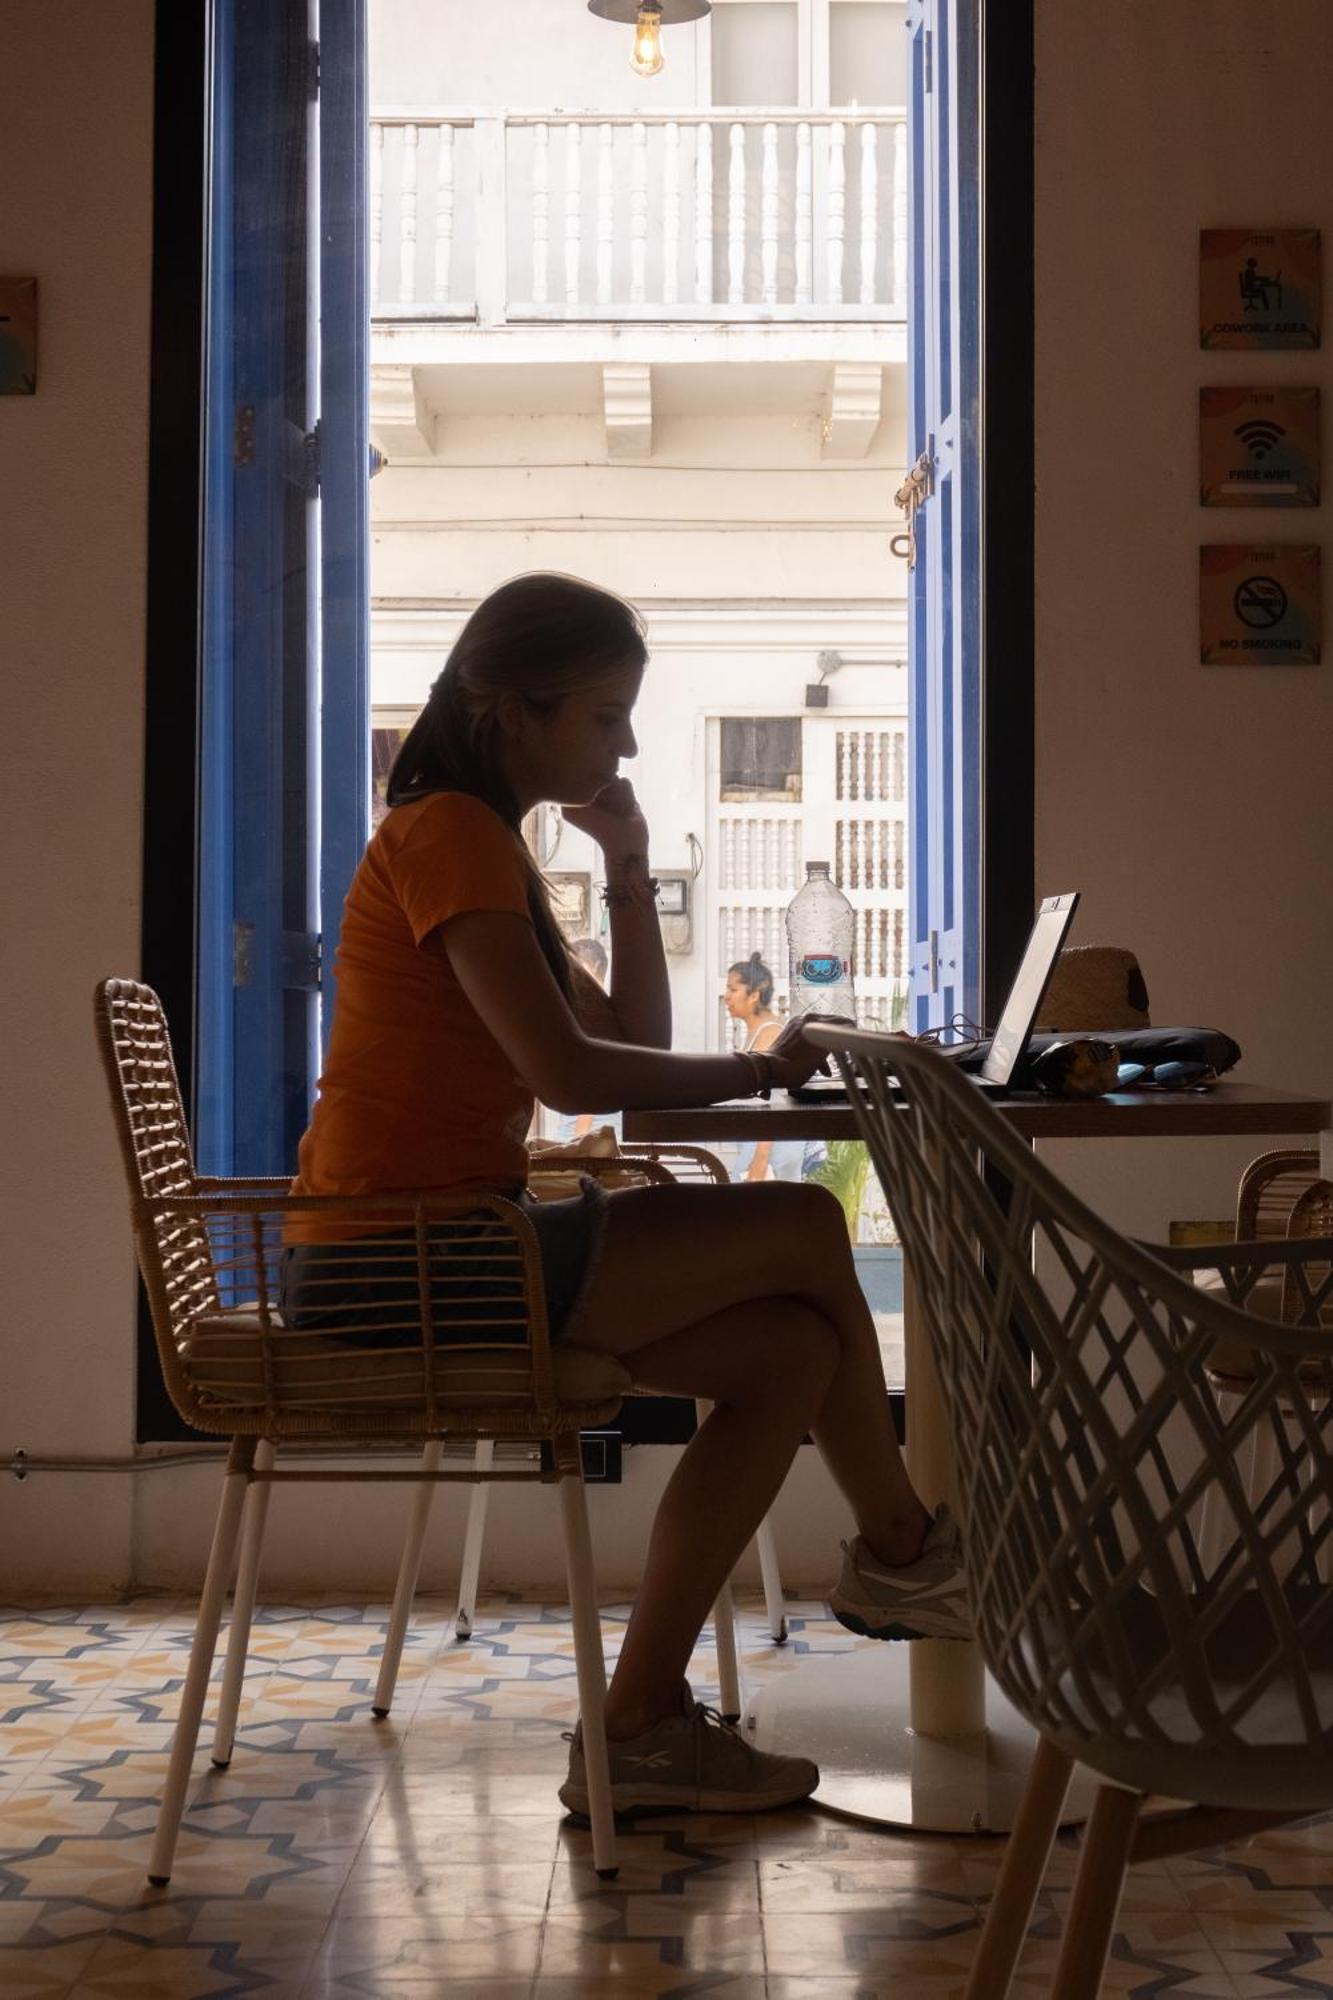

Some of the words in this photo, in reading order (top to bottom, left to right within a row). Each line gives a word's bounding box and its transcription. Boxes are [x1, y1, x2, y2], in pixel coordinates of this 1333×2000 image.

[1213, 323, 1270, 333] COWORK
[1274, 323, 1308, 333] AREA
[1227, 470, 1261, 480] FREE
[1264, 470, 1290, 480] WIFI
[1219, 640, 1238, 649] NO
[1242, 640, 1302, 649] SMOKING
